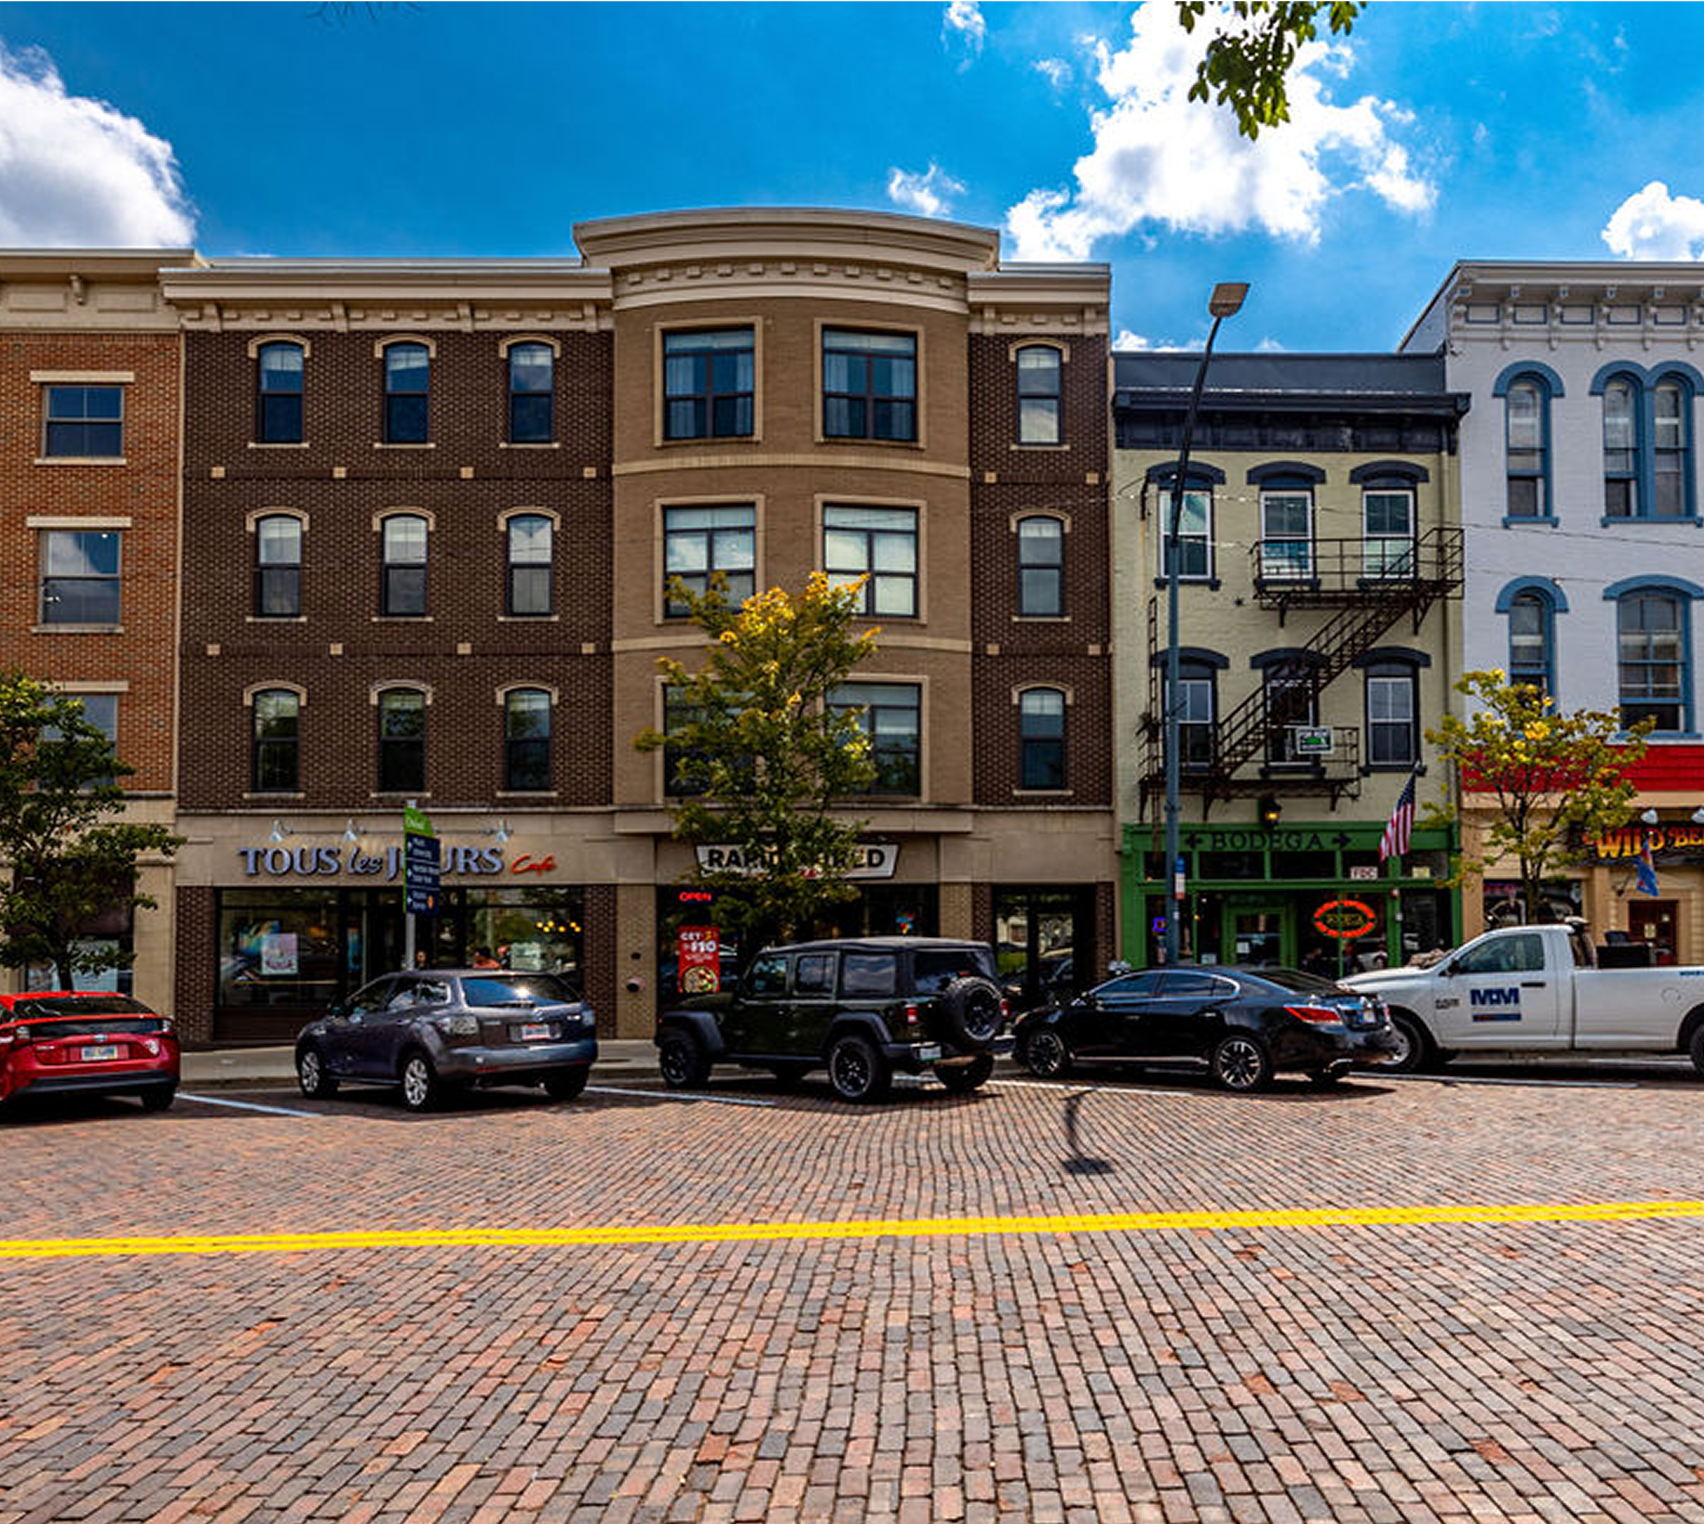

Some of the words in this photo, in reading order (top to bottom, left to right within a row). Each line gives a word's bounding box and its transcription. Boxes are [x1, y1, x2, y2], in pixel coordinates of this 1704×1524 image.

[1211, 831, 1324, 850] BODEGA
[1667, 825, 1704, 848] BE
[238, 847, 341, 875] TOUS
[346, 847, 383, 875] les
[385, 846, 505, 882] JURS
[679, 891, 712, 902] OPEN
